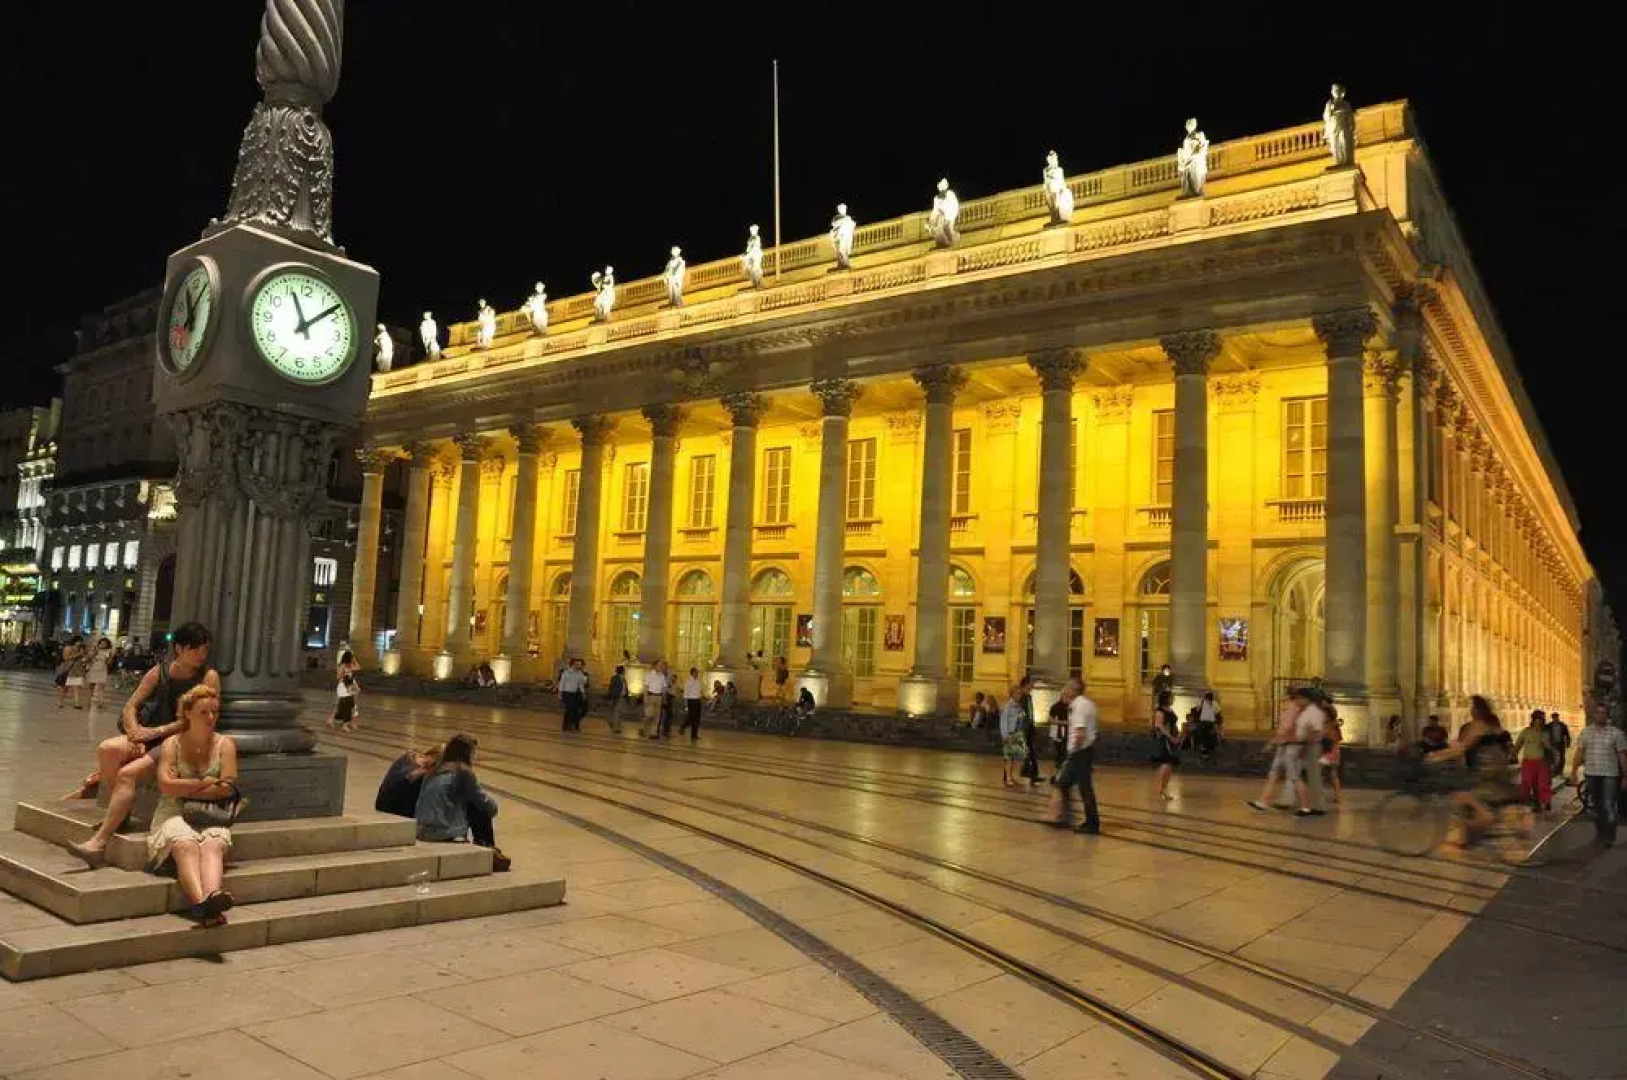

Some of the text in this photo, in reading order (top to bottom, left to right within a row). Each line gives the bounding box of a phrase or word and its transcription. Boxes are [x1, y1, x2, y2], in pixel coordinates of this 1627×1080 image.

[300, 284, 313, 298] 12
[269, 295, 282, 308] 10
[263, 311, 272, 323] 9
[331, 312, 339, 324] 2
[266, 330, 275, 342] 8
[332, 330, 341, 342] 3
[278, 346, 288, 358] 7
[295, 357, 304, 368] 6
[313, 356, 321, 368] 5
